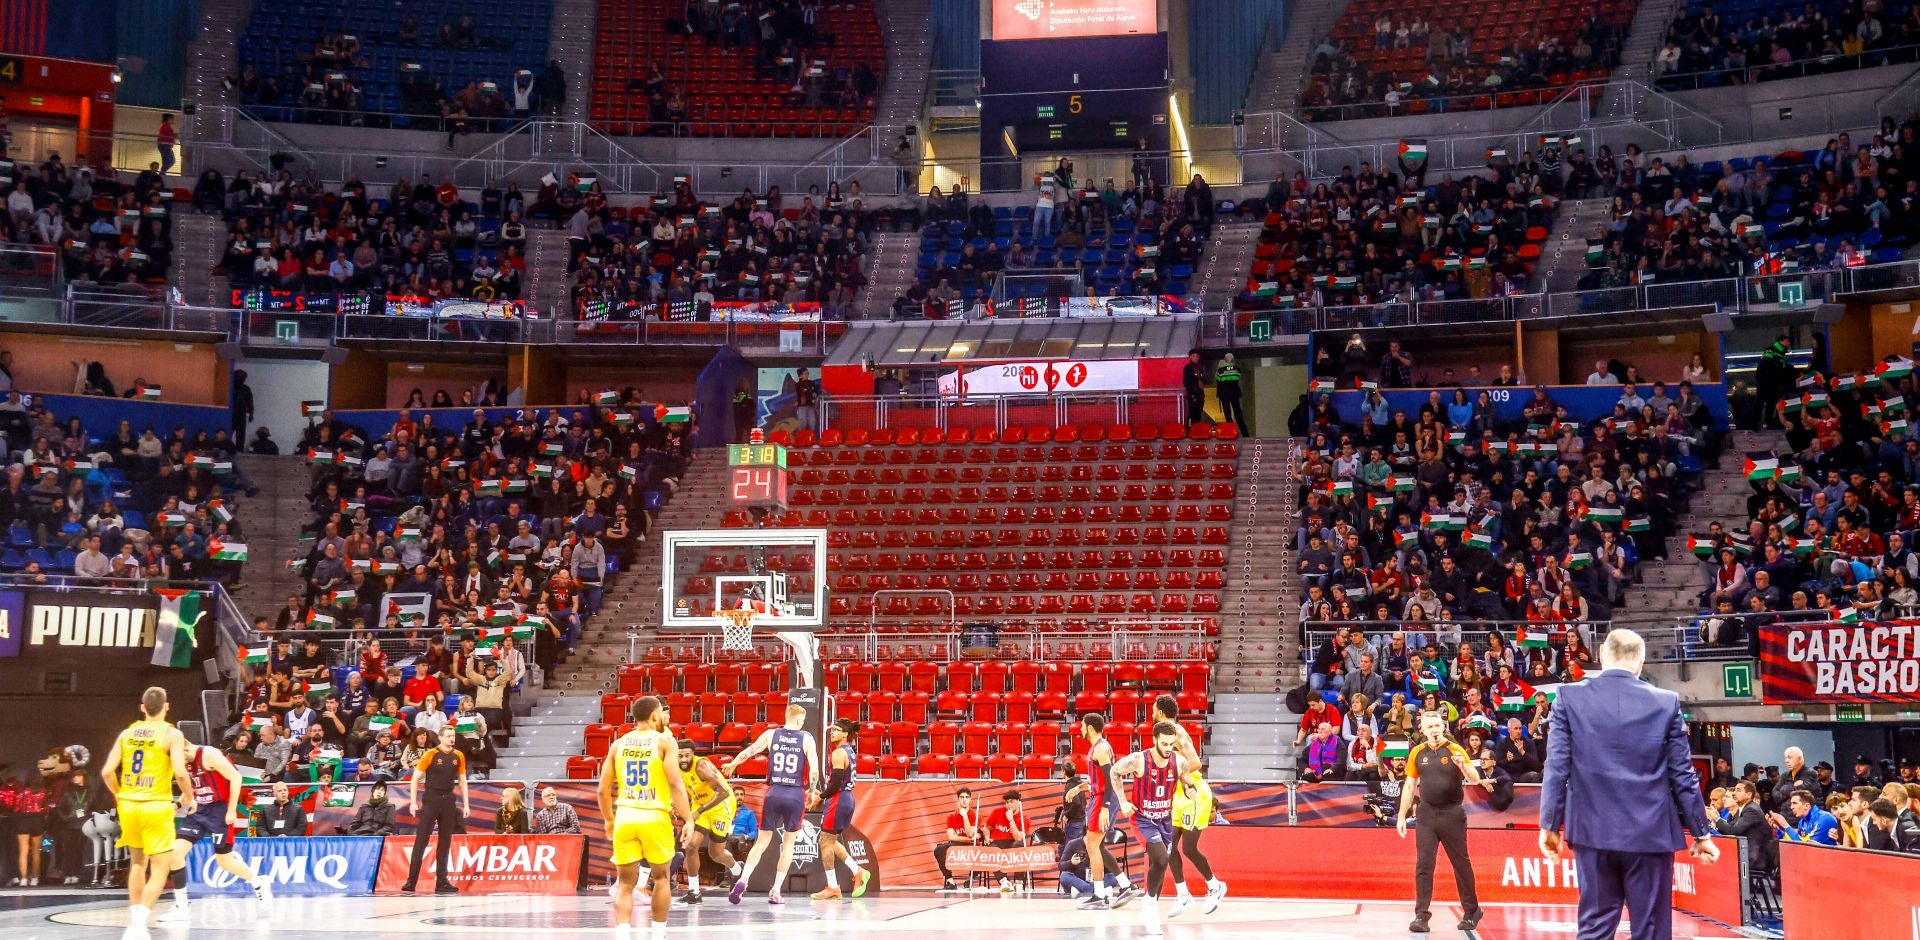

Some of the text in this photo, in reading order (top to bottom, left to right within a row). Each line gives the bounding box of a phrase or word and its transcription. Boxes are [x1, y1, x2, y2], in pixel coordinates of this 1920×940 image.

[1, 61, 16, 80] 4
[1069, 95, 1082, 114] 5
[516, 409, 540, 421] 27
[740, 446, 774, 464] 3:18
[733, 469, 771, 499] 24
[30, 605, 157, 648] PUMA
[1815, 660, 1920, 694] BASKO
[131, 749, 144, 774] 8
[622, 748, 652, 759] Rapyd
[773, 752, 799, 774] 99
[625, 760, 649, 787] 55
[1155, 785, 1165, 798] 0
[428, 845, 558, 873] AMBAR
[947, 849, 1000, 862] AlkiVent
[1000, 849, 1055, 865] AlkiVent
[245, 854, 350, 890] IMQ
